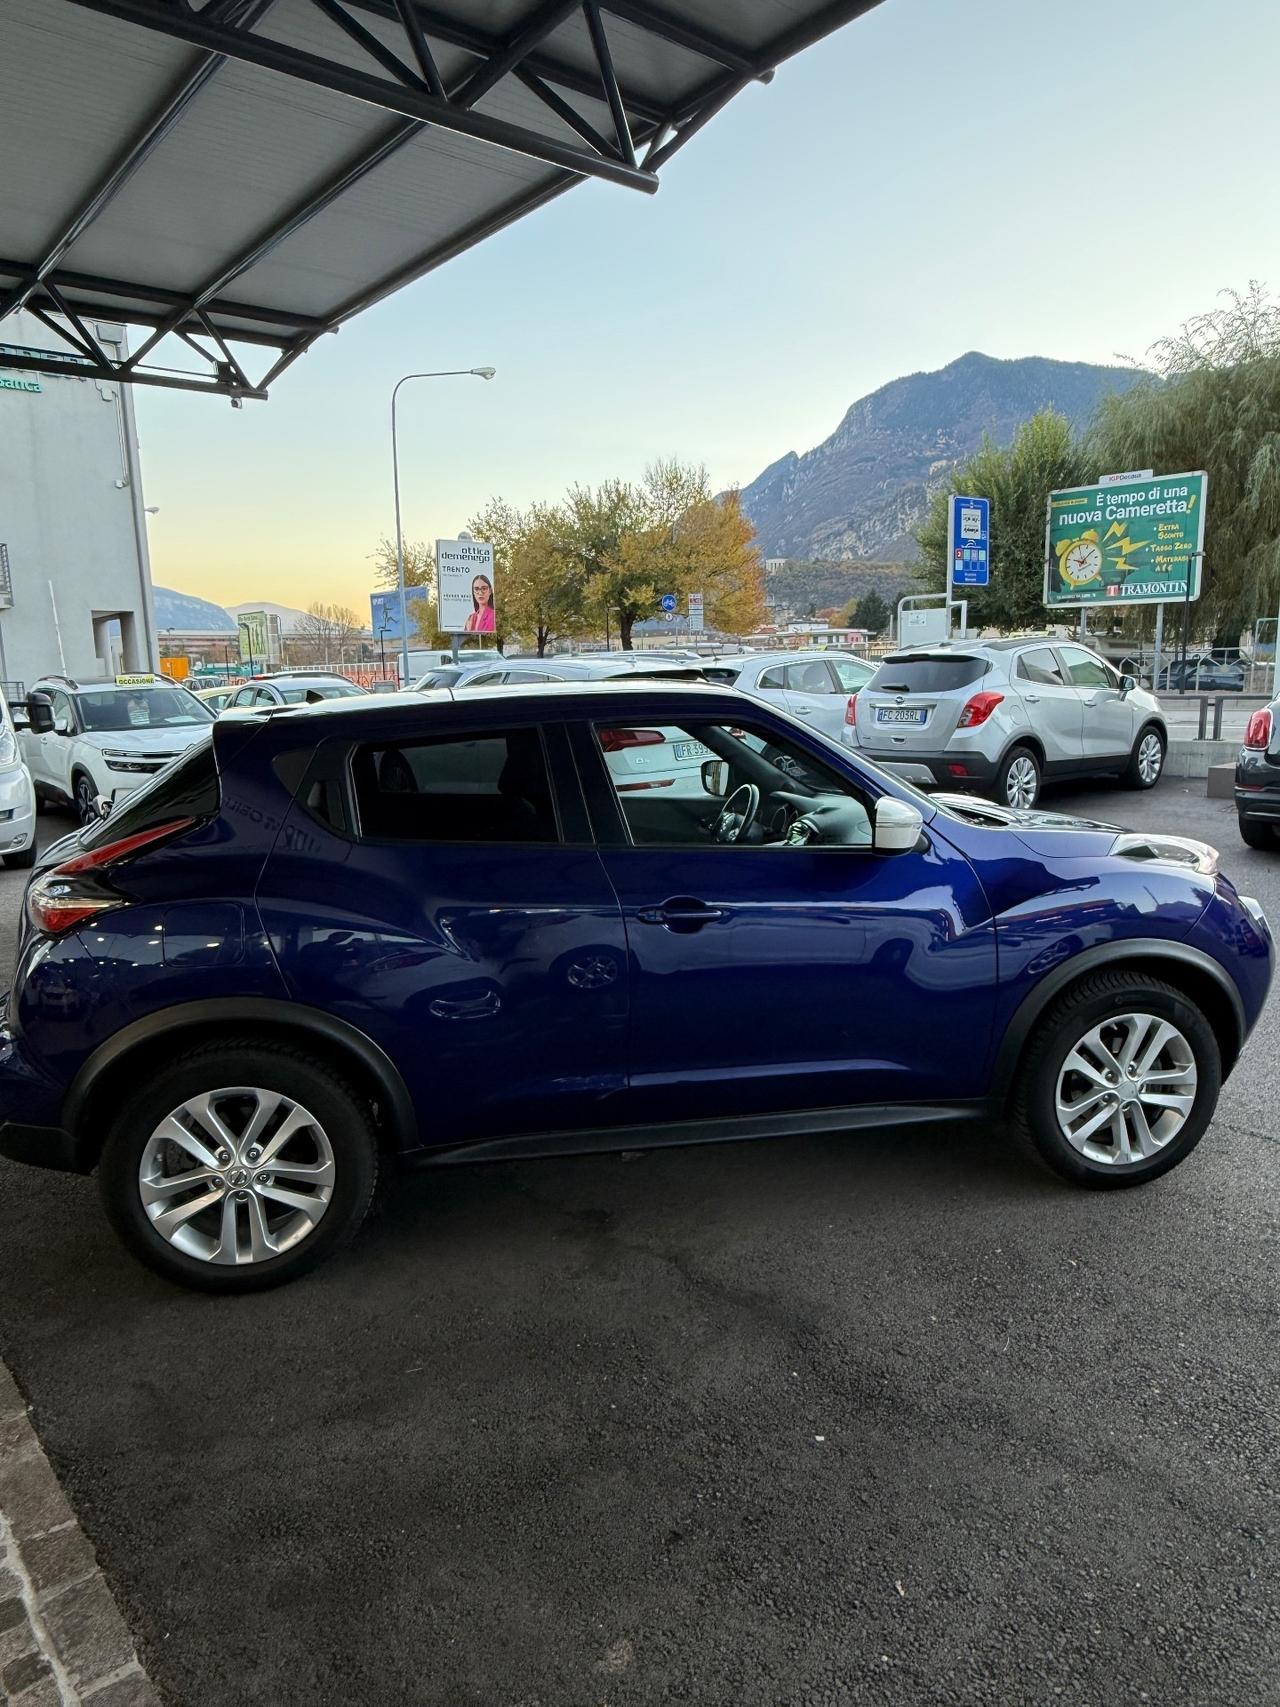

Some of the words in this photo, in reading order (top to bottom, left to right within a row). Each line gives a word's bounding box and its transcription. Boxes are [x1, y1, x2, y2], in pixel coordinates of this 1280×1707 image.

[1096, 493, 1104, 506] È
[1106, 491, 1141, 507] tempo
[1148, 487, 1160, 500] di
[1163, 486, 1188, 498] una
[1059, 511, 1102, 526] nuova
[1105, 495, 1197, 520] Cameretta!
[461, 547, 490, 556] ottica
[441, 552, 490, 564] demenego
[442, 566, 470, 574] TRENTO
[681, 744, 692, 756] FR
